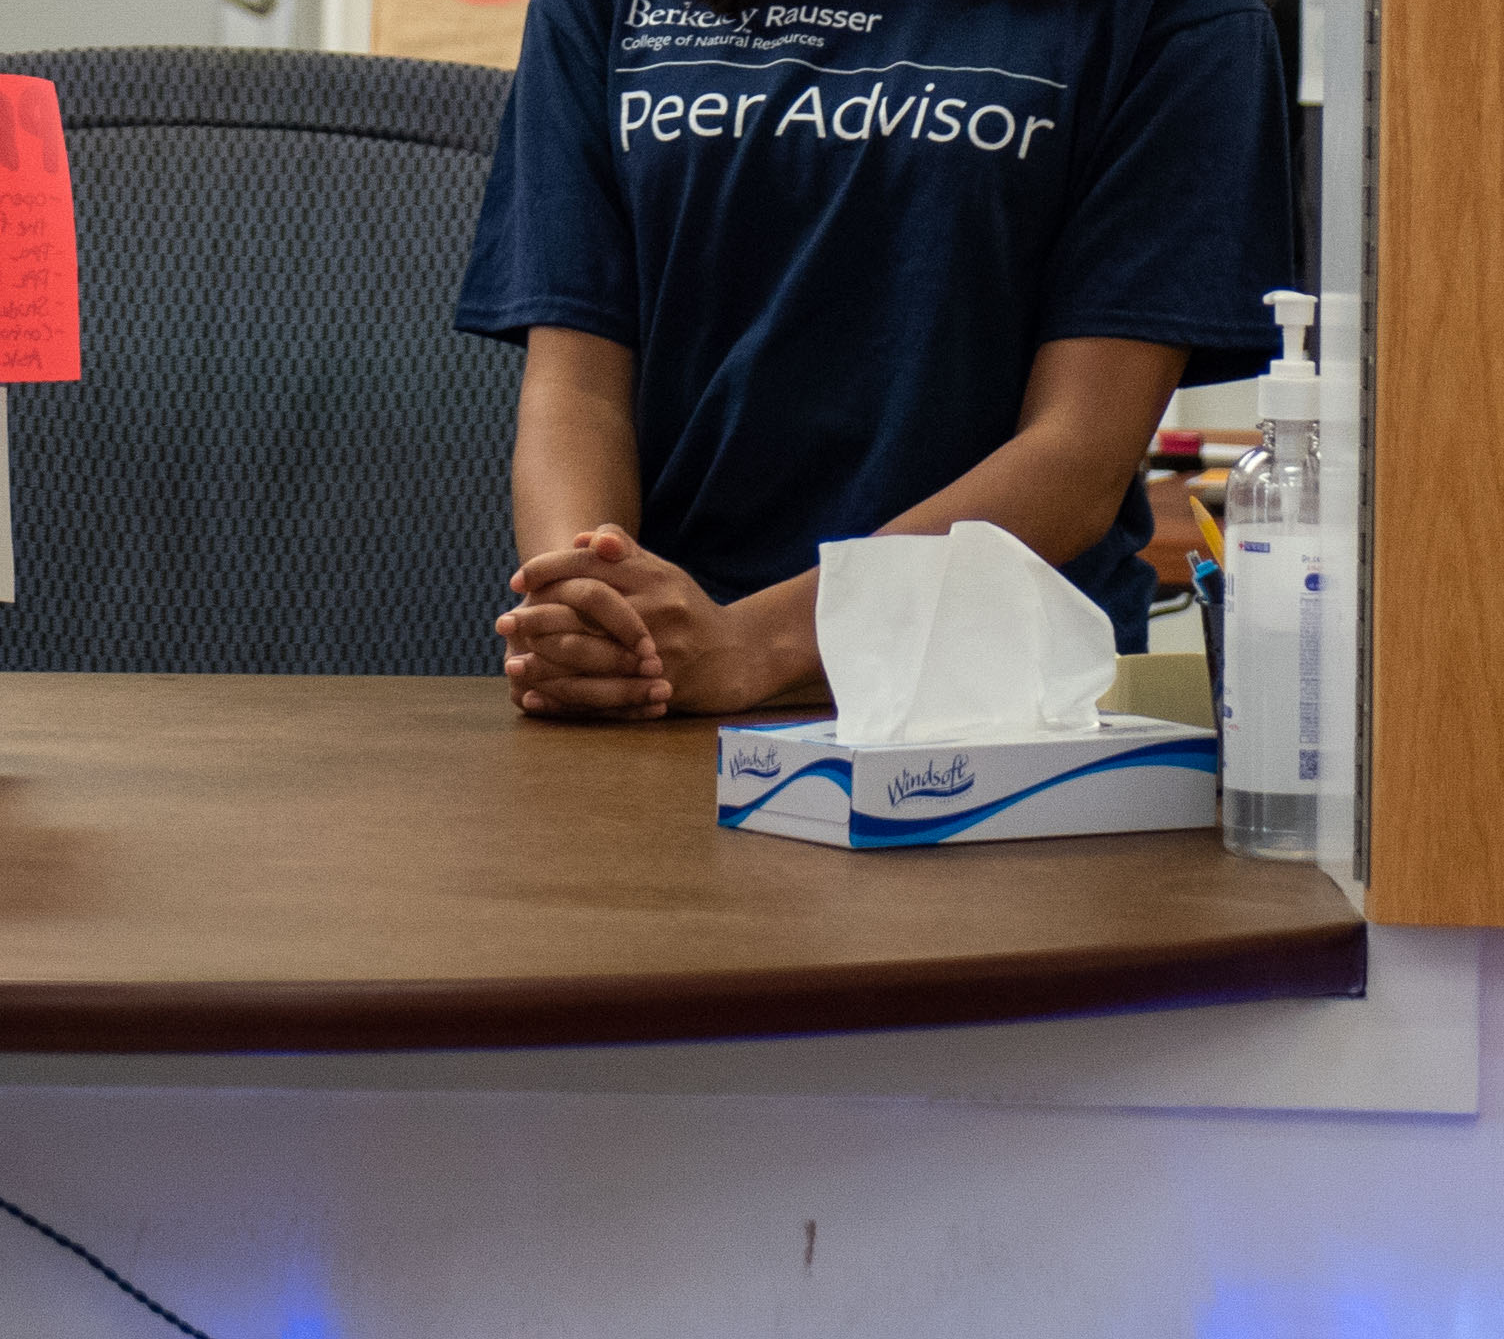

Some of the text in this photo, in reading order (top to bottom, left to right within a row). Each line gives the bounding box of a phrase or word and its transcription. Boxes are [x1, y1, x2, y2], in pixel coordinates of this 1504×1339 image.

[765, 5, 882, 33] Rausser
[621, 33, 825, 51] College of Natural Resources
[619, 81, 1055, 159] Peer Advisor
[730, 743, 780, 779] Windsoft
[888, 754, 969, 809] Windsoft
